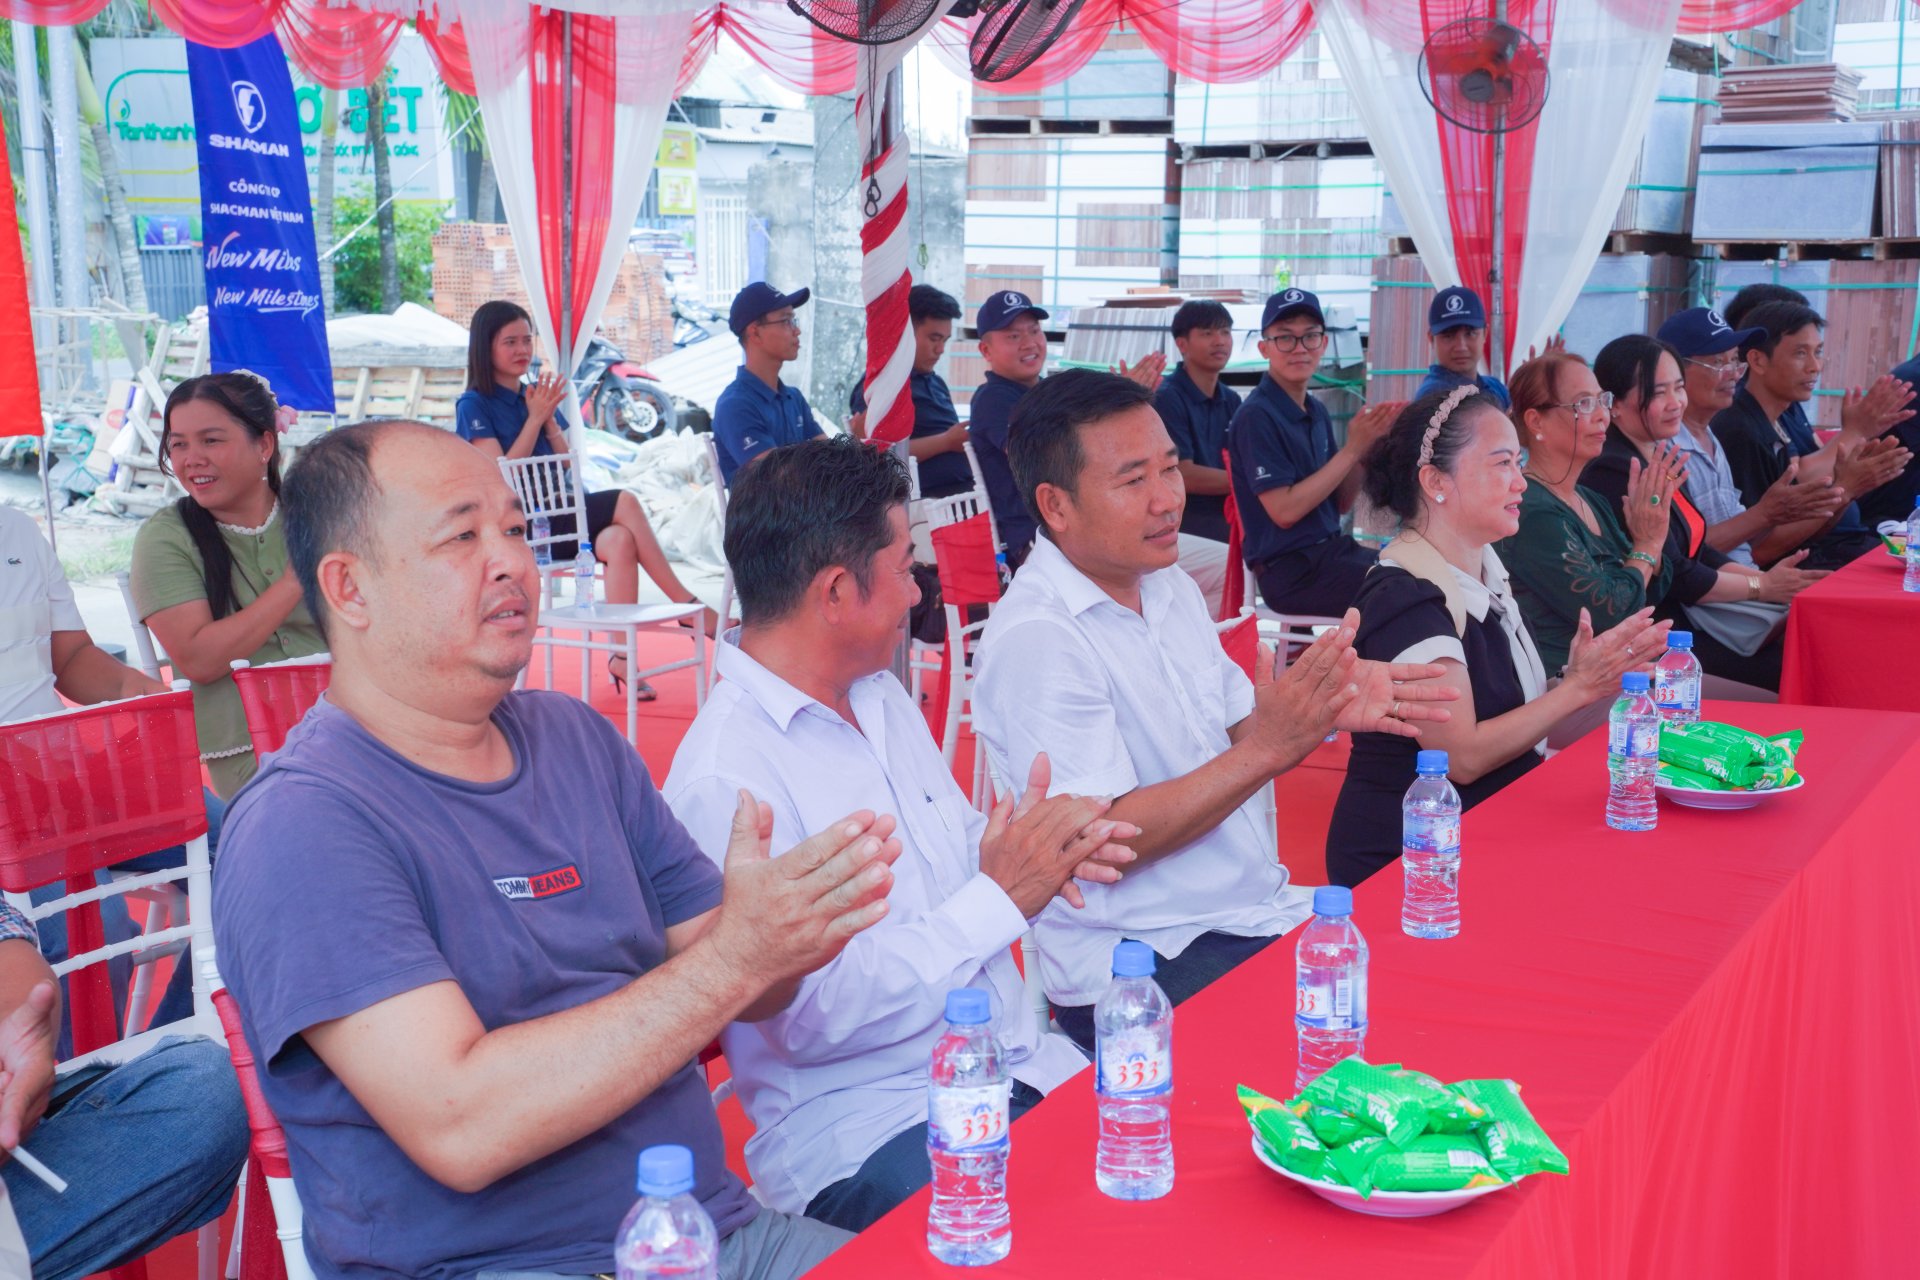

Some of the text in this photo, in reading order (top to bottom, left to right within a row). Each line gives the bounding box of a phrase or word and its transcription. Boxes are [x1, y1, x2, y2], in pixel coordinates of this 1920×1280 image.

[205, 231, 252, 270] New
[214, 286, 319, 314] New Milestnes
[497, 870, 576, 895] TOMMY JEANS
[1115, 1060, 1158, 1090] 333
[957, 1111, 1002, 1145] 333
